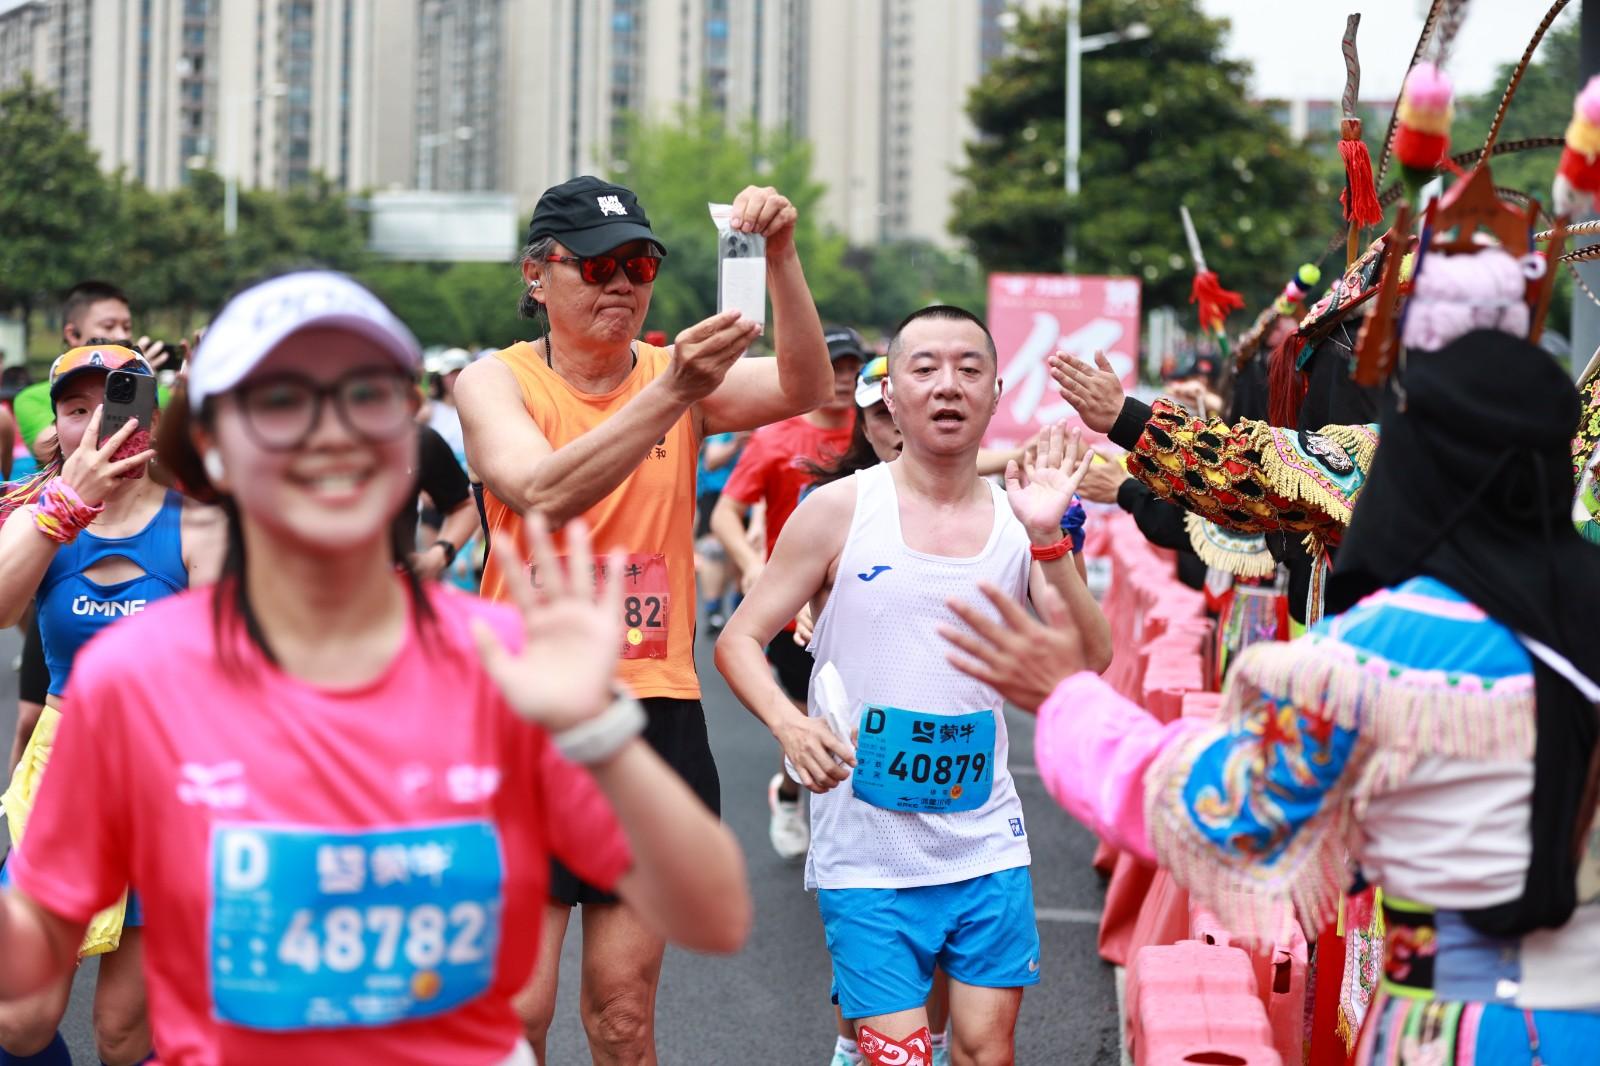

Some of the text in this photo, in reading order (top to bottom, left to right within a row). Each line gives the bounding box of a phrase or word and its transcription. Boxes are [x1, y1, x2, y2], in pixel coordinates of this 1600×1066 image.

[865, 707, 886, 734] D
[940, 723, 976, 744] 蒙牛
[887, 751, 986, 785] 40879
[221, 832, 269, 891] D
[277, 902, 485, 974] 48782
